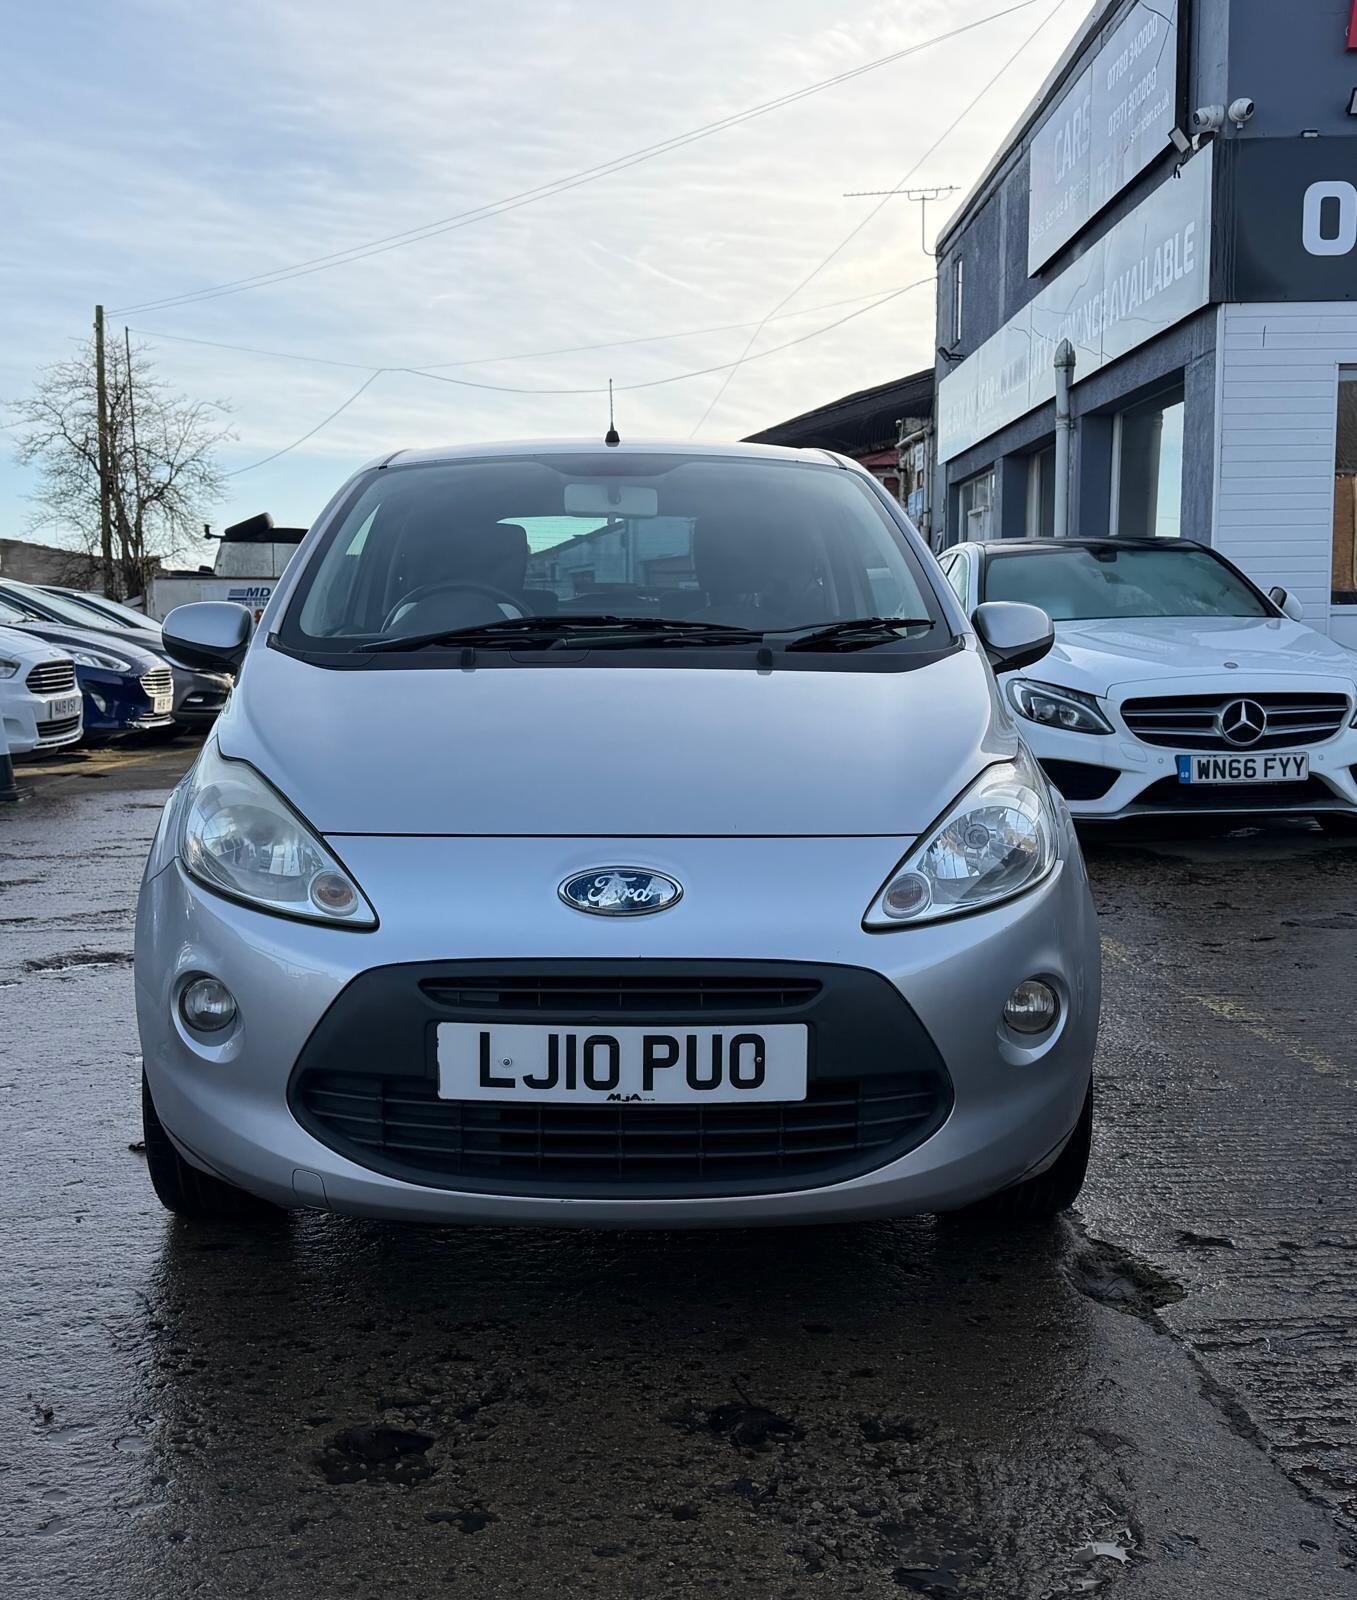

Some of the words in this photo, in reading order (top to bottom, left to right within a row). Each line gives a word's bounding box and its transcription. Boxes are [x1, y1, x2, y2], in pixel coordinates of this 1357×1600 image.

[1054, 94, 1091, 185] CARS
[1110, 221, 1196, 327] AVAILABLE
[1197, 759, 1257, 779] WN66
[1263, 756, 1305, 778] FYY
[587, 874, 655, 902] Ford
[479, 1031, 620, 1091] LJ10
